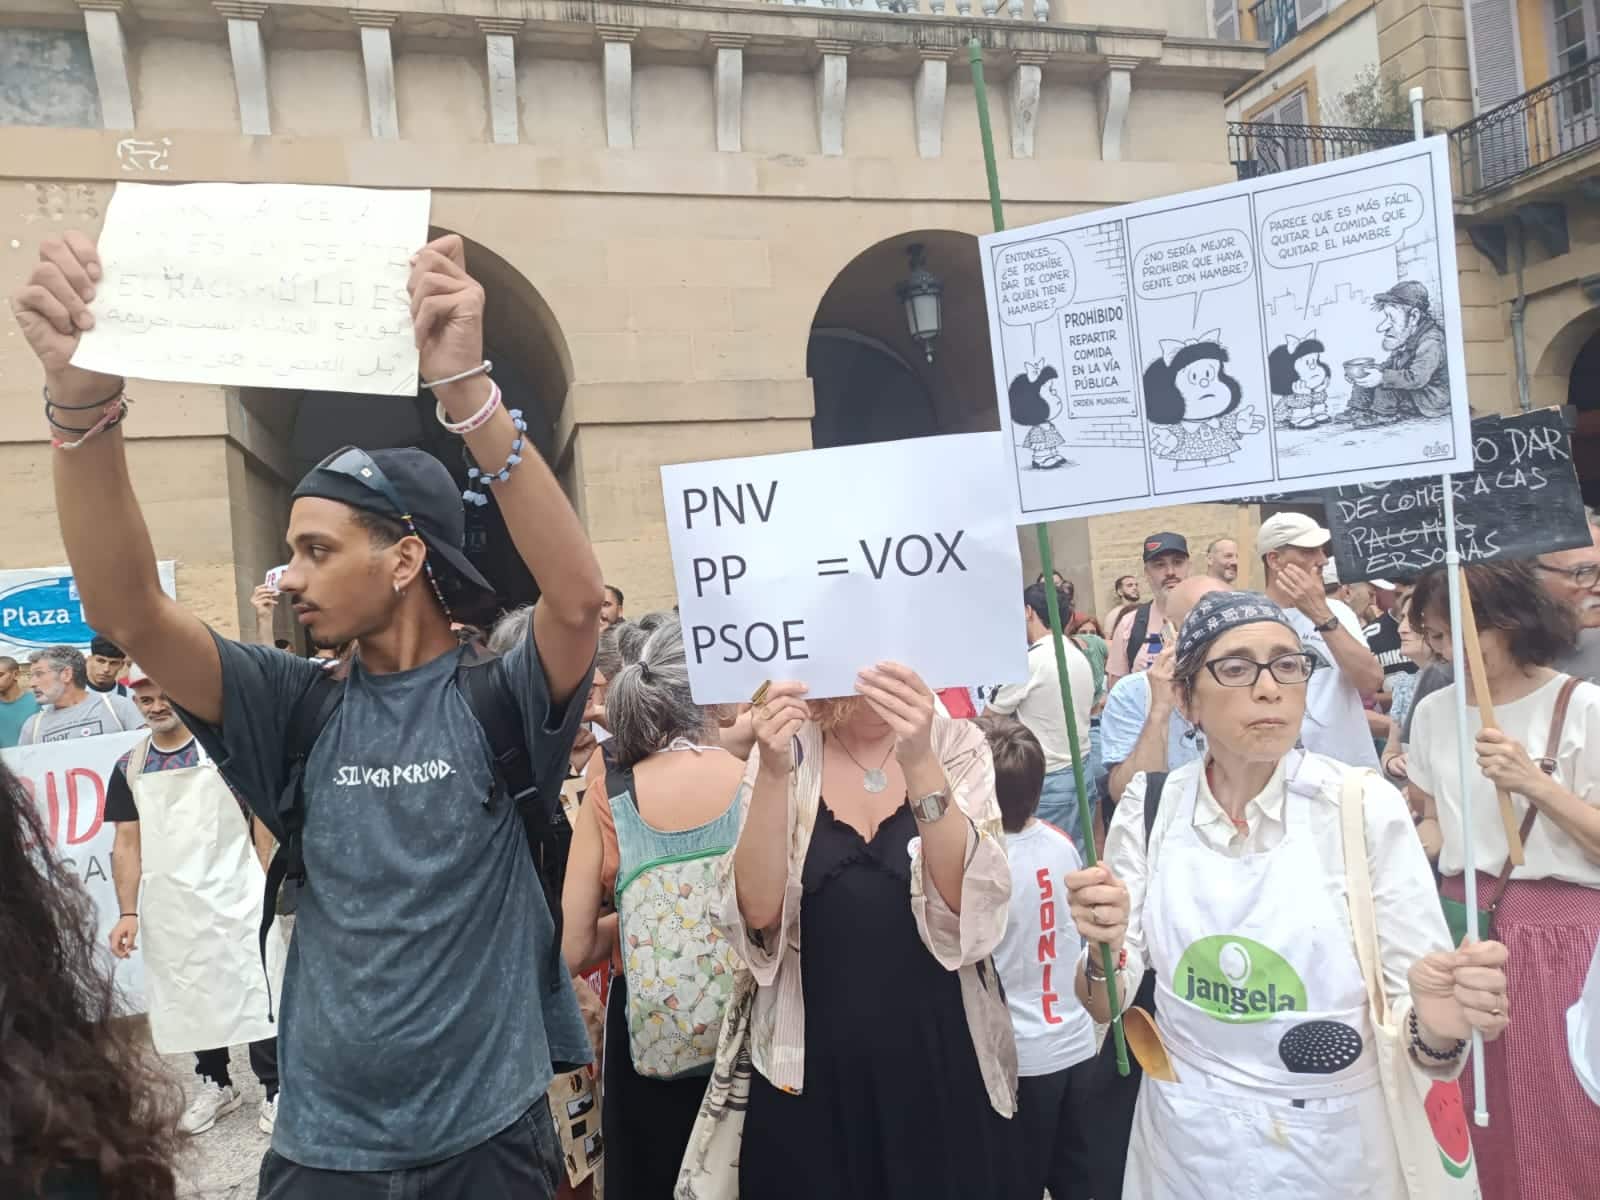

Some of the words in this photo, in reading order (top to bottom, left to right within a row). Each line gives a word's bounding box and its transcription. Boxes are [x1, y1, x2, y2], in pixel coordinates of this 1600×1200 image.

[1269, 215, 1308, 232] PARECE
[1312, 210, 1334, 224] QUE
[1338, 206, 1352, 218] ES
[1355, 198, 1381, 214] MÁS
[1385, 192, 1414, 208] FÁCIL
[1271, 228, 1310, 246] QUITAR
[1315, 225, 1329, 238] LA
[1334, 215, 1377, 233] COMIDA
[1382, 208, 1407, 223] QUE
[1143, 250, 1164, 266] ¿NO
[1167, 242, 1197, 259] SERÍA
[1201, 236, 1237, 252] MEJOR
[1278, 241, 1319, 259] QUITAR
[1324, 239, 1338, 251] EL
[1342, 226, 1393, 247] HAMBRE
[1002, 266, 1020, 281] ¿SE
[1142, 259, 1189, 278] PROHIBIR
[1191, 255, 1213, 269] QUE
[1216, 249, 1244, 263] HAYA
[1142, 276, 1174, 291] GENTE
[1176, 272, 1196, 285] CON
[1200, 260, 1249, 280] HAMBRE?
[1001, 279, 1020, 292] DAR
[1024, 275, 1037, 287] DE
[1039, 269, 1071, 283] COMER
[1002, 294, 1010, 304] A
[1041, 282, 1066, 297] TIENE
[1007, 297, 1057, 316] HAMBRE?
[1064, 306, 1124, 329] PROHIBIDO
[1069, 329, 1118, 347] REPARTIR
[1072, 364, 1085, 376] EN
[1088, 362, 1101, 374] LA
[1103, 357, 1121, 372] VÍA
[1073, 346, 1113, 361] COMIDA
[1074, 375, 1119, 391] PÚBLICA
[1504, 427, 1570, 465] DAR
[682, 479, 779, 530] PNV
[1337, 494, 1379, 523] DE
[1473, 473, 1491, 496] A
[1347, 513, 1477, 558] PALOMS
[692, 554, 748, 598] PP
[858, 530, 968, 580] VOX
[2, 606, 71, 628] Plaza
[691, 619, 809, 665] PSOE
[1035, 867, 1063, 1026] SONIC
[1185, 966, 1296, 1015] jangela
